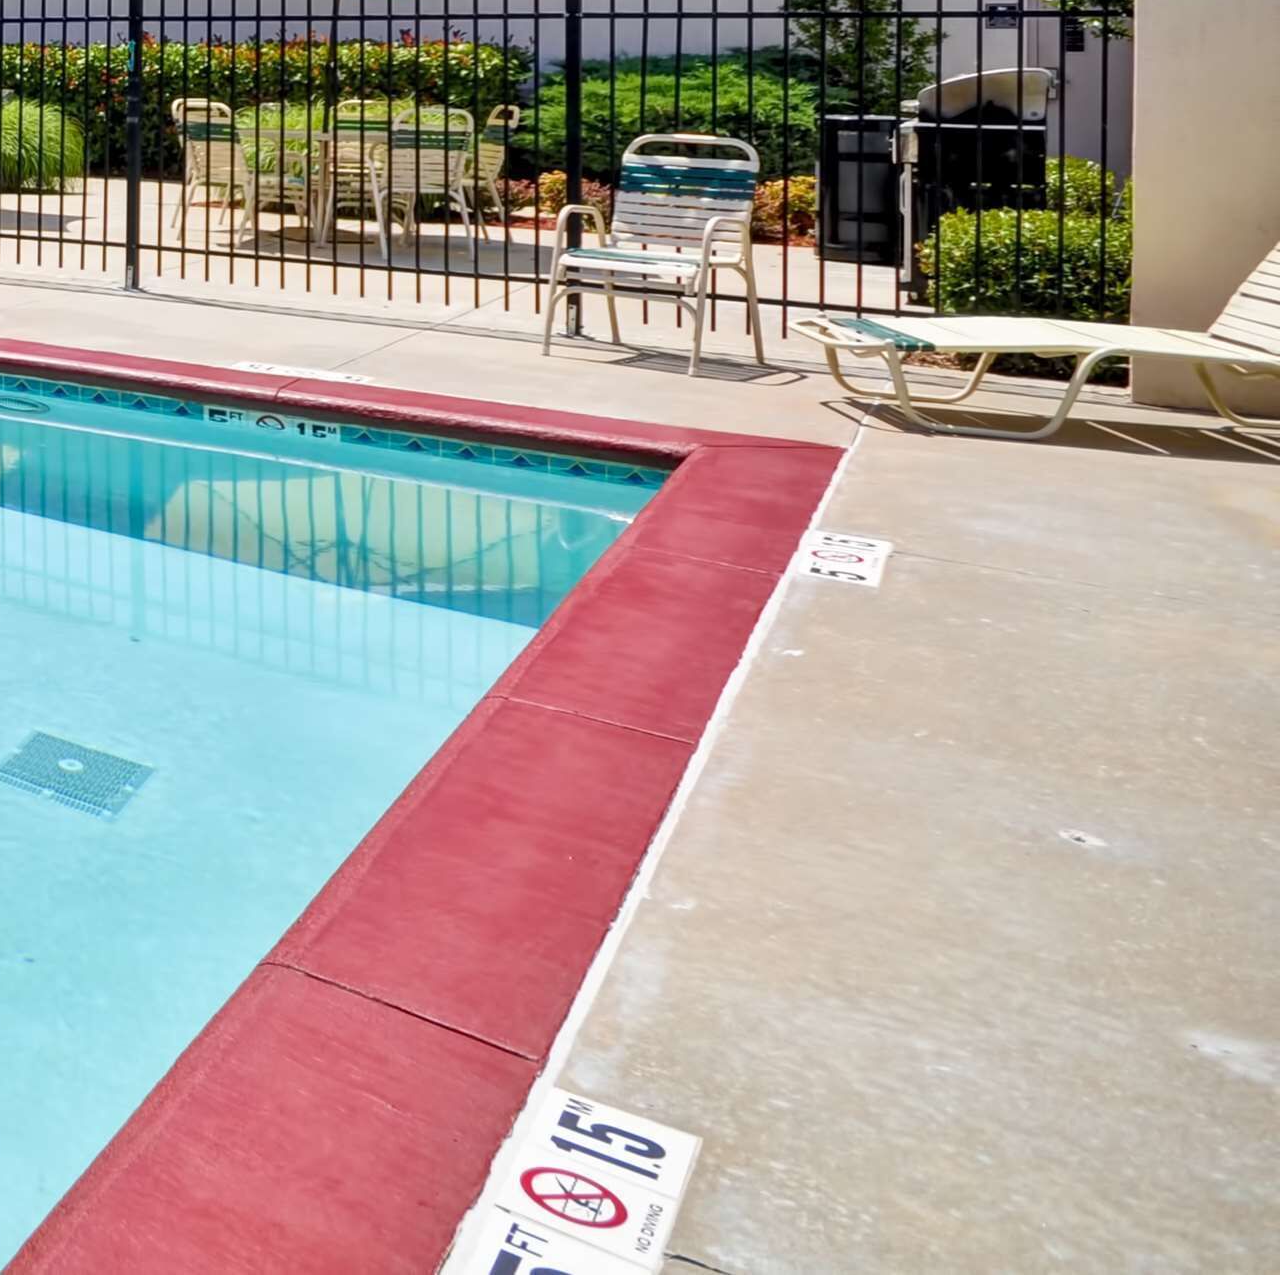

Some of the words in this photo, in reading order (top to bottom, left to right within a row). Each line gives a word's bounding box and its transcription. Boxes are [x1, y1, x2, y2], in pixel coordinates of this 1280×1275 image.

[565, 1097, 594, 1116] M
[550, 1110, 666, 1180] 1.5
[640, 1204, 664, 1239] DIVING
[504, 1222, 549, 1258] FT
[635, 1236, 651, 1254] NO
